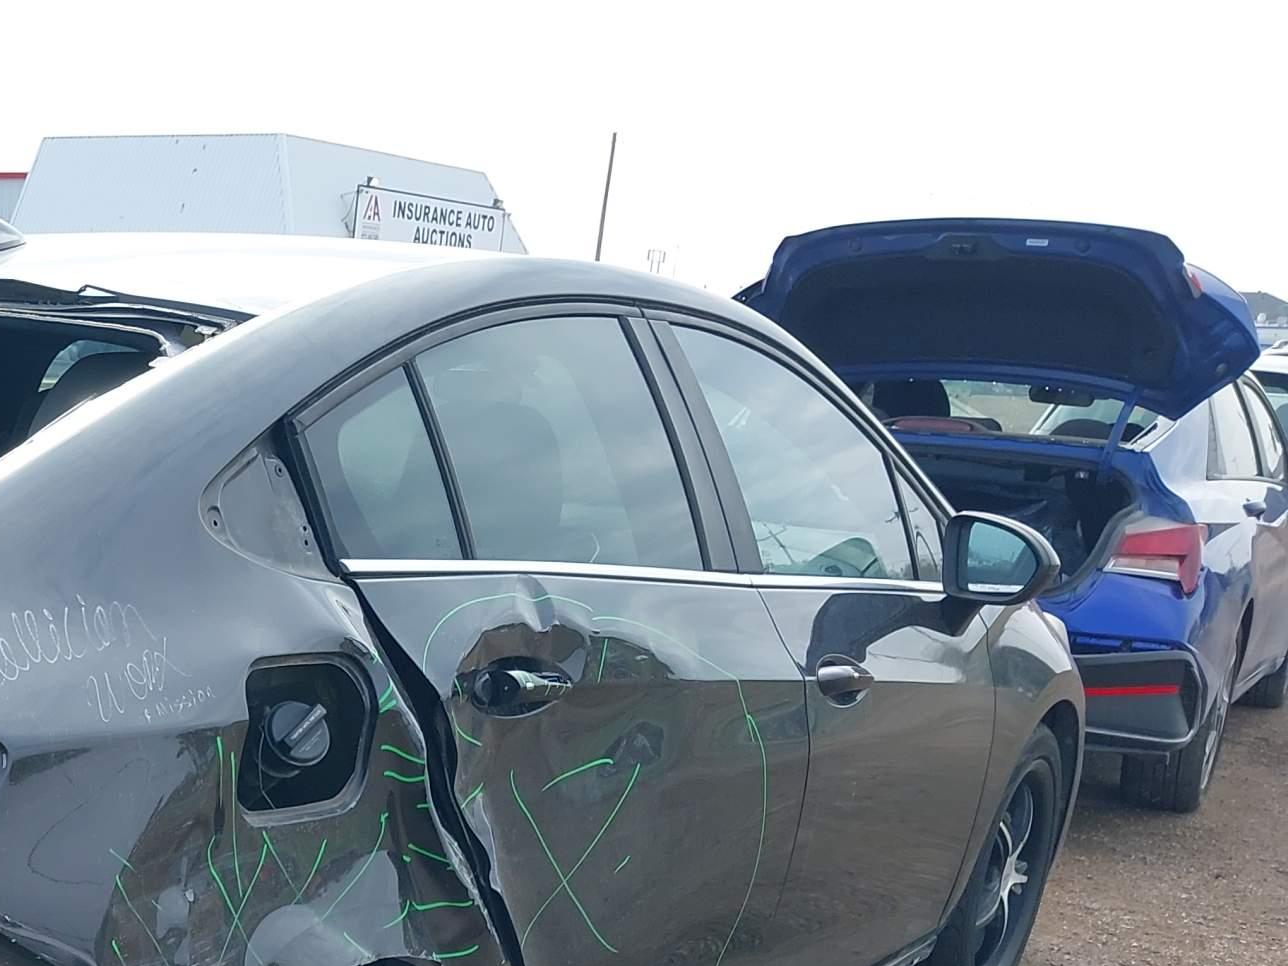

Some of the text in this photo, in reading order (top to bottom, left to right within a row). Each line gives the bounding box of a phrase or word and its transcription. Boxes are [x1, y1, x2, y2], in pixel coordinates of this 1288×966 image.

[392, 200, 495, 232] INSURANCE AUTO
[413, 226, 472, 249] AUCTIONS
